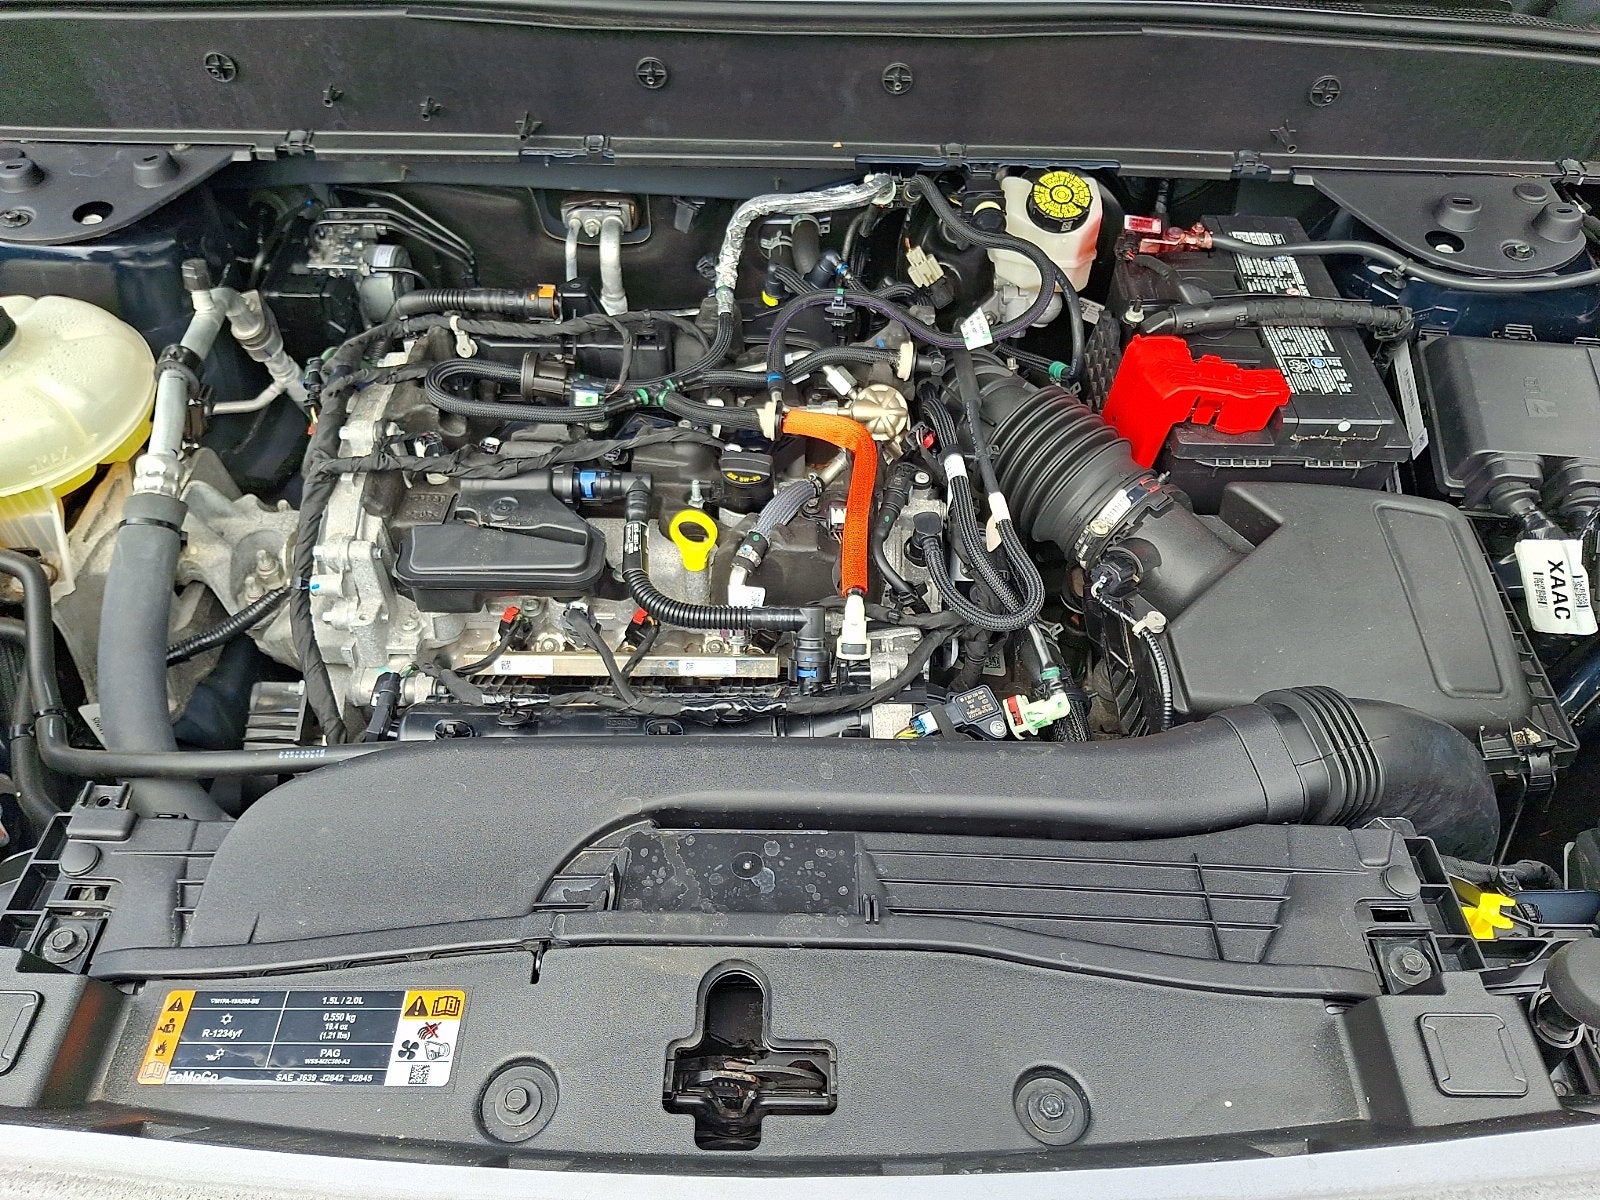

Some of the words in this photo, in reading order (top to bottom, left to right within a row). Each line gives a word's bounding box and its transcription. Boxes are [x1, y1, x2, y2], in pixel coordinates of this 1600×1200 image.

[1547, 559, 1571, 620] XAAC
[322, 996, 339, 1005] 1.5L
[346, 996, 364, 1005] 2.0L
[323, 1012, 345, 1022] 0.550
[346, 1012, 357, 1023] kg
[325, 1023, 339, 1031] 19.4
[202, 1028, 244, 1039] R-1234yf
[319, 1031, 336, 1041] (1.21
[337, 1031, 351, 1041] lbs)
[319, 1048, 341, 1058] PAG
[166, 1070, 219, 1082] FoMoCo
[275, 1073, 294, 1082] SAE
[296, 1073, 317, 1082] J639
[320, 1074, 344, 1082] J2842
[348, 1074, 374, 1082] J2845
